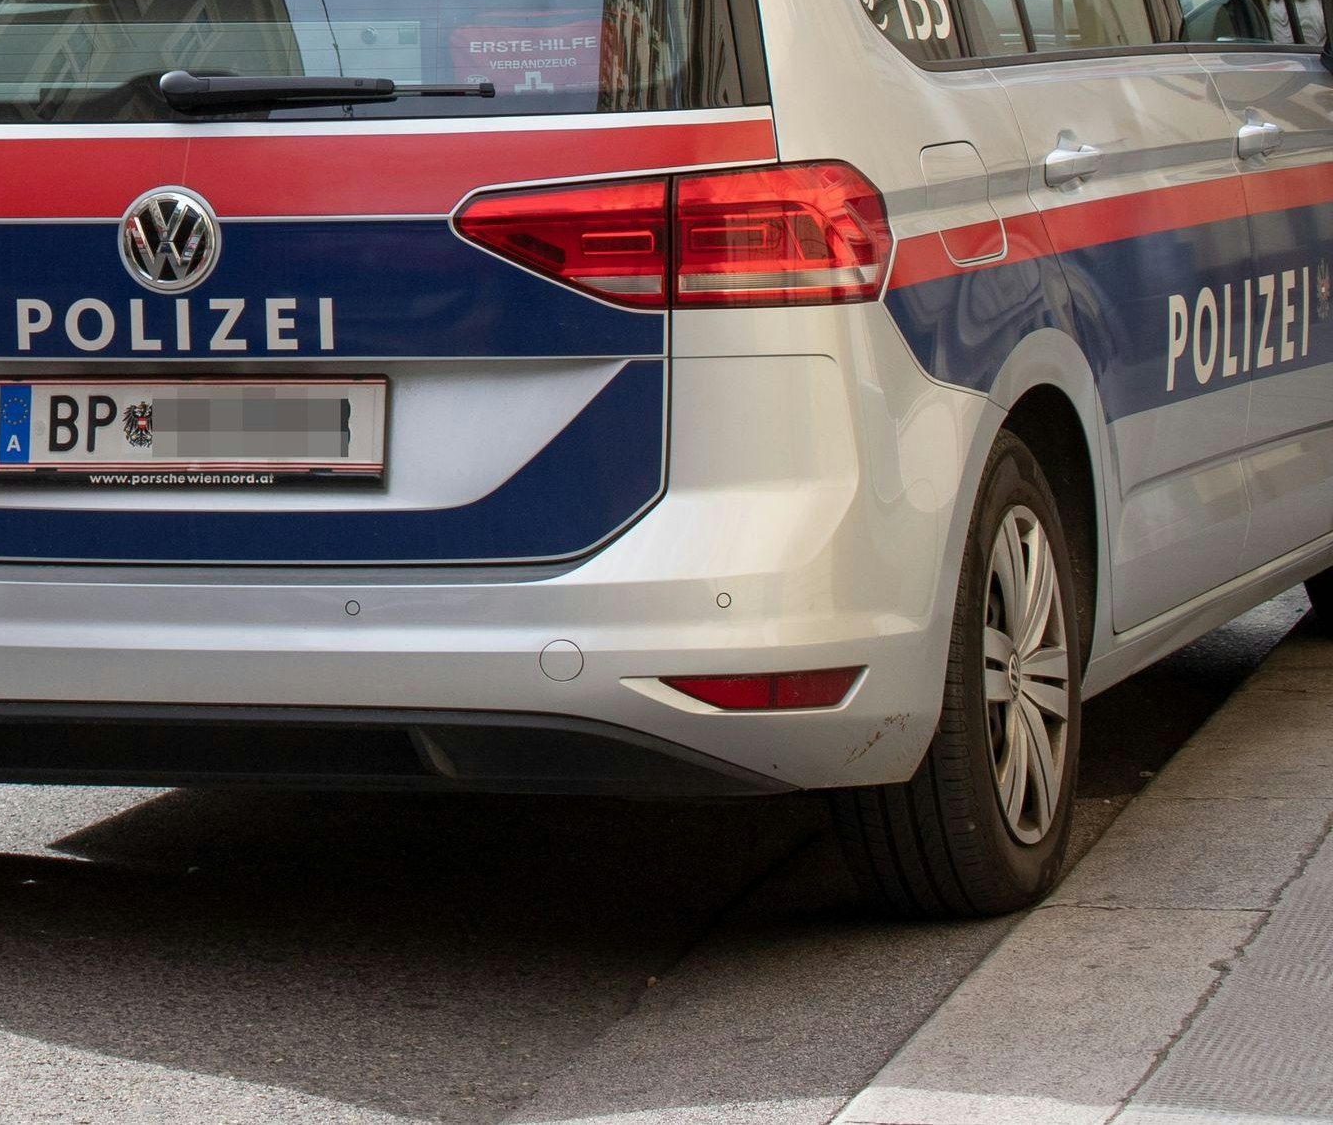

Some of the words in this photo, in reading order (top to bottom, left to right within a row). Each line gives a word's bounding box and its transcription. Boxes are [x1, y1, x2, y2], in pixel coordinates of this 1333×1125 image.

[469, 36, 598, 54] ERSTE-HILFE
[489, 57, 578, 71] VERBANDZEUG
[128, 193, 215, 285] VW
[16, 297, 335, 352] POLIZEI
[1165, 266, 1311, 393] POLIZEI
[6, 435, 22, 452] A
[48, 395, 119, 453] BP
